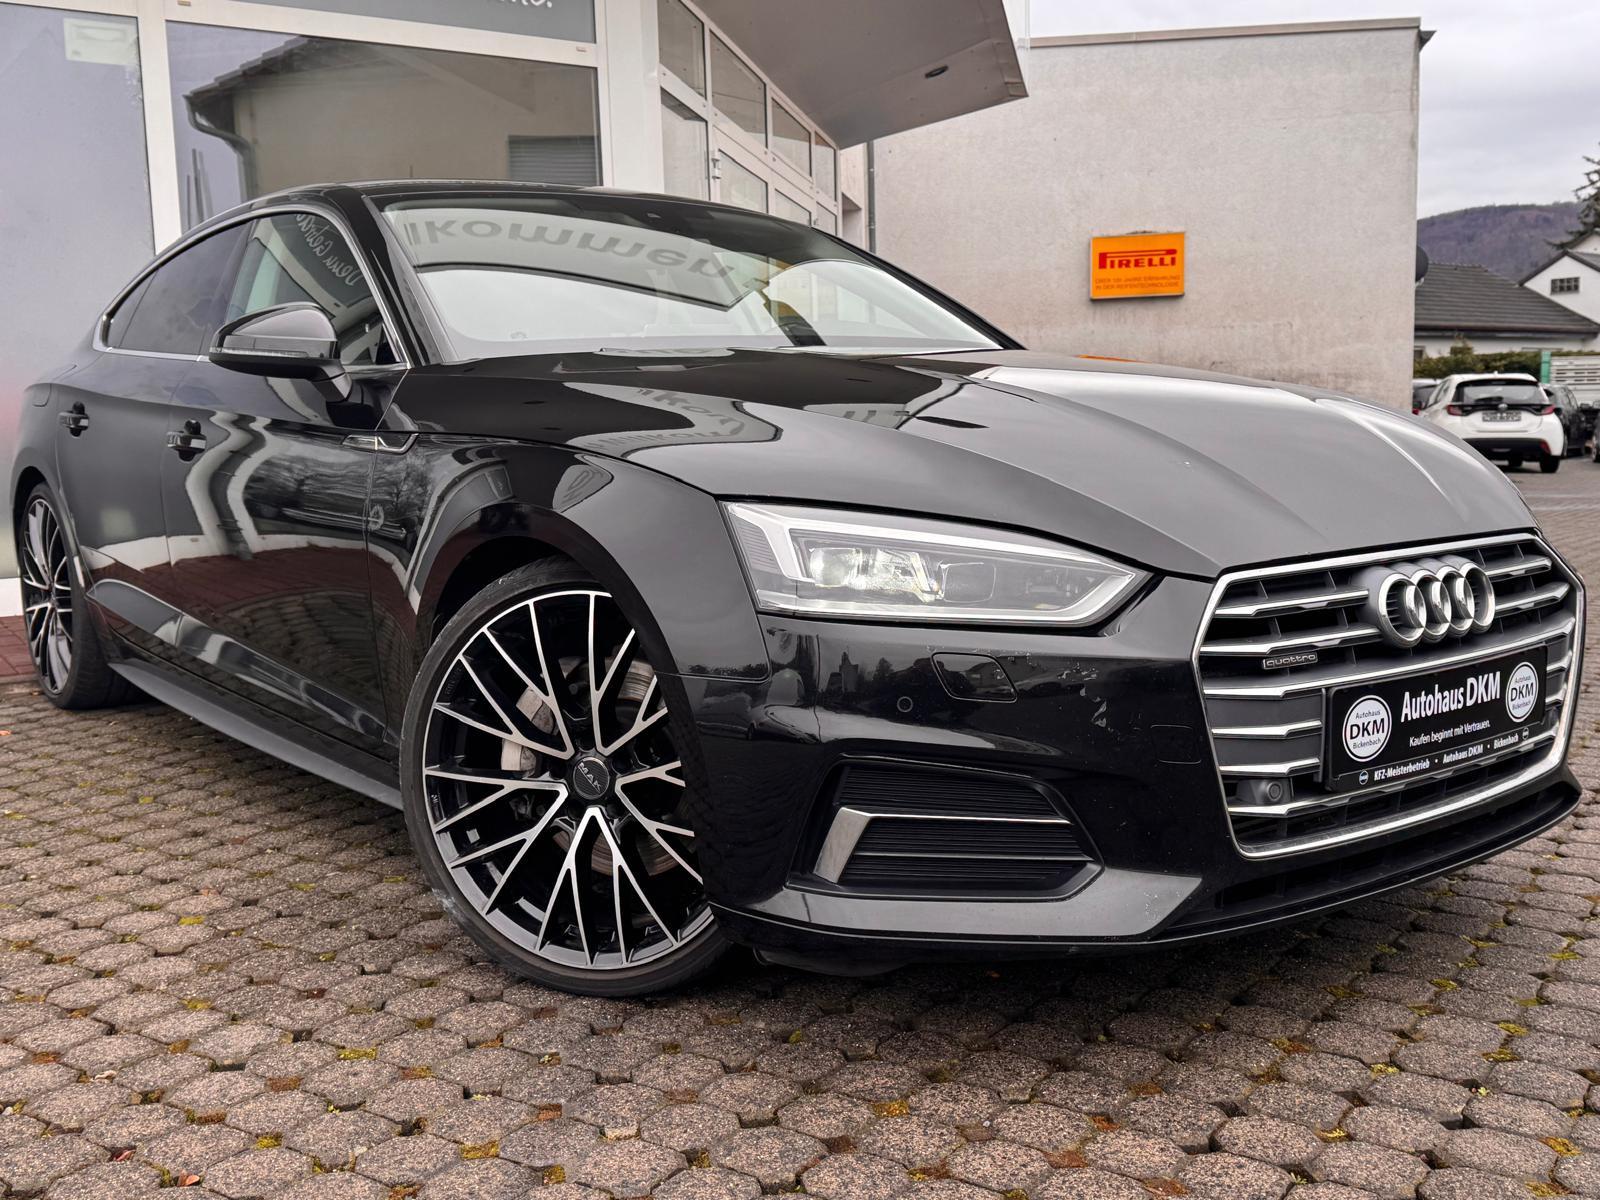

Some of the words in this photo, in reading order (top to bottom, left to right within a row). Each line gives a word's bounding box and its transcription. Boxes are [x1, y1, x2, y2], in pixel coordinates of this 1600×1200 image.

[1098, 249, 1177, 269] PIRELLI
[1266, 654, 1316, 668] quattro
[1401, 684, 1464, 723] Autohaus
[1466, 671, 1501, 707] DKM
[1510, 682, 1534, 702] DKM
[1355, 710, 1381, 720] Autohaus
[1350, 717, 1385, 740] DKM
[1409, 733, 1431, 747] Kaufen
[1431, 728, 1454, 742] beginnt
[1454, 725, 1464, 736] mit
[1464, 720, 1491, 733] Vertrauen.
[1352, 737, 1382, 750] Bickenbach
[1374, 758, 1430, 781] KFZ-Meisterbetrieb
[1442, 750, 1468, 764] Autohaus
[1468, 743, 1484, 757] DKM
[1493, 733, 1519, 750] Bickenbach
[577, 762, 601, 792] MAK
